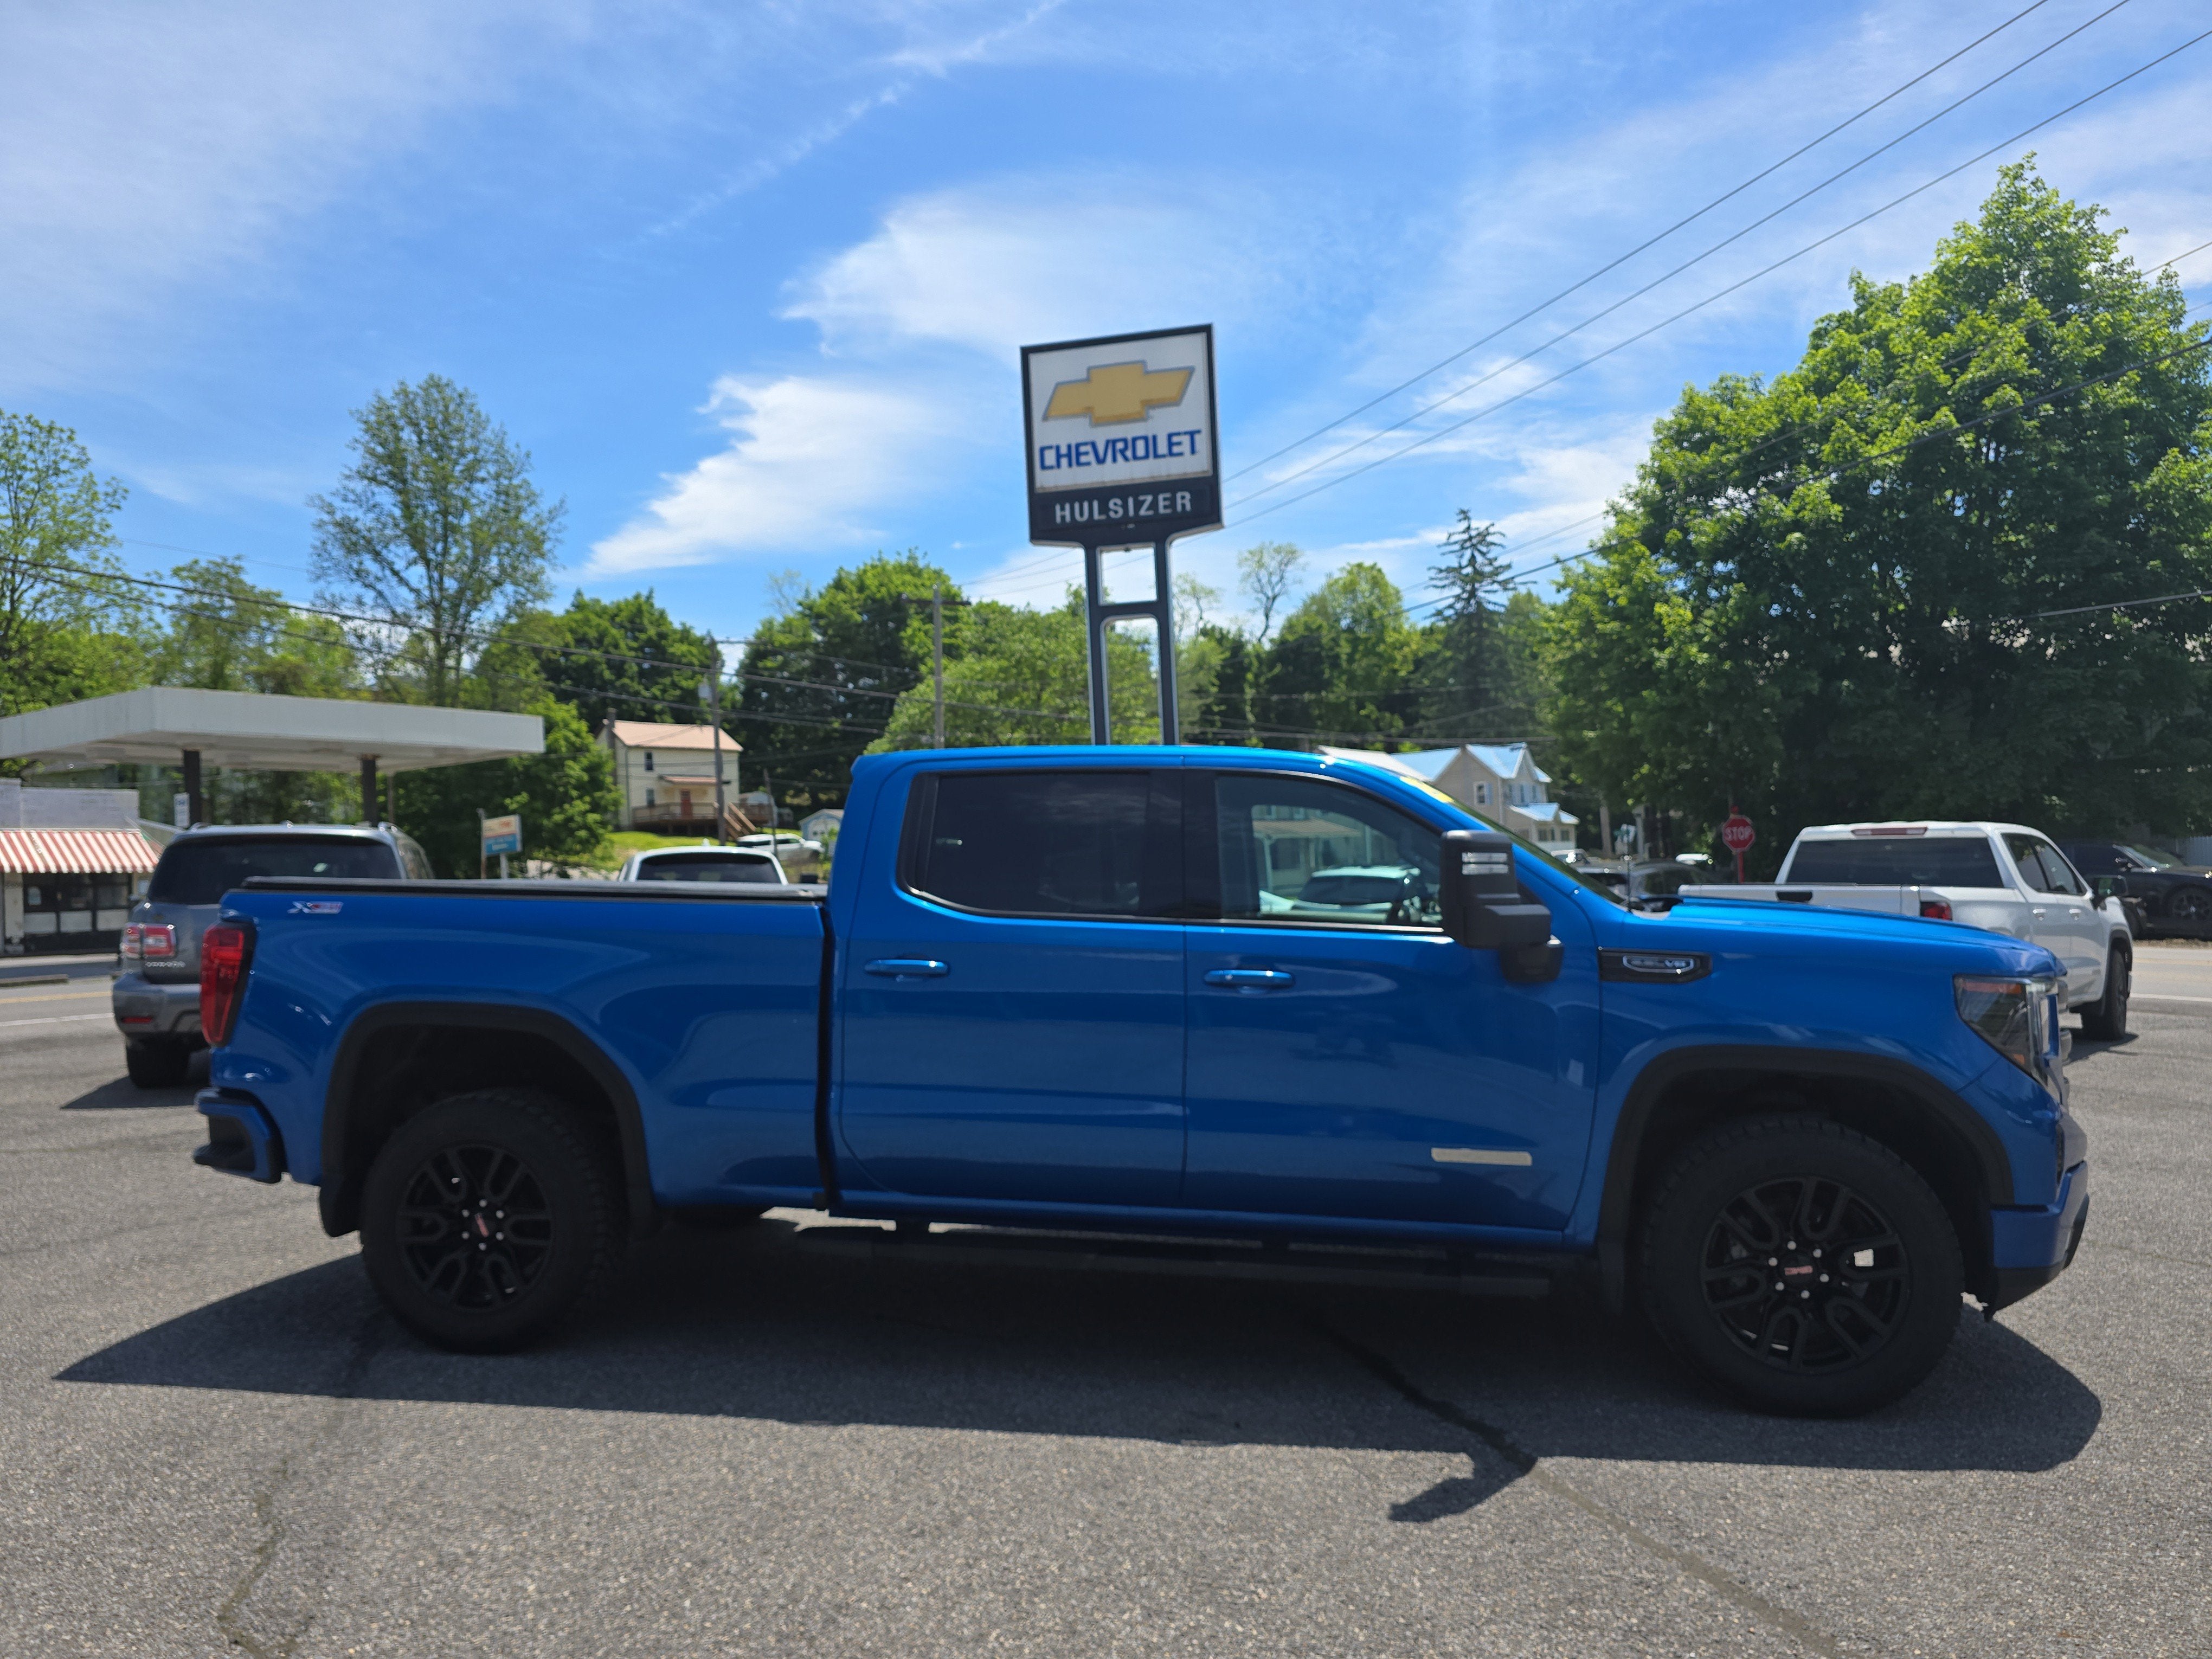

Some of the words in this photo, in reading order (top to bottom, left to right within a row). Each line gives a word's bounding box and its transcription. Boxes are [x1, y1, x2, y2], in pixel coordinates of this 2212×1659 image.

[1039, 429, 1201, 471] CHEVROLET
[1055, 491, 1192, 524] HULSIZER
[1725, 826, 1752, 841] STOP
